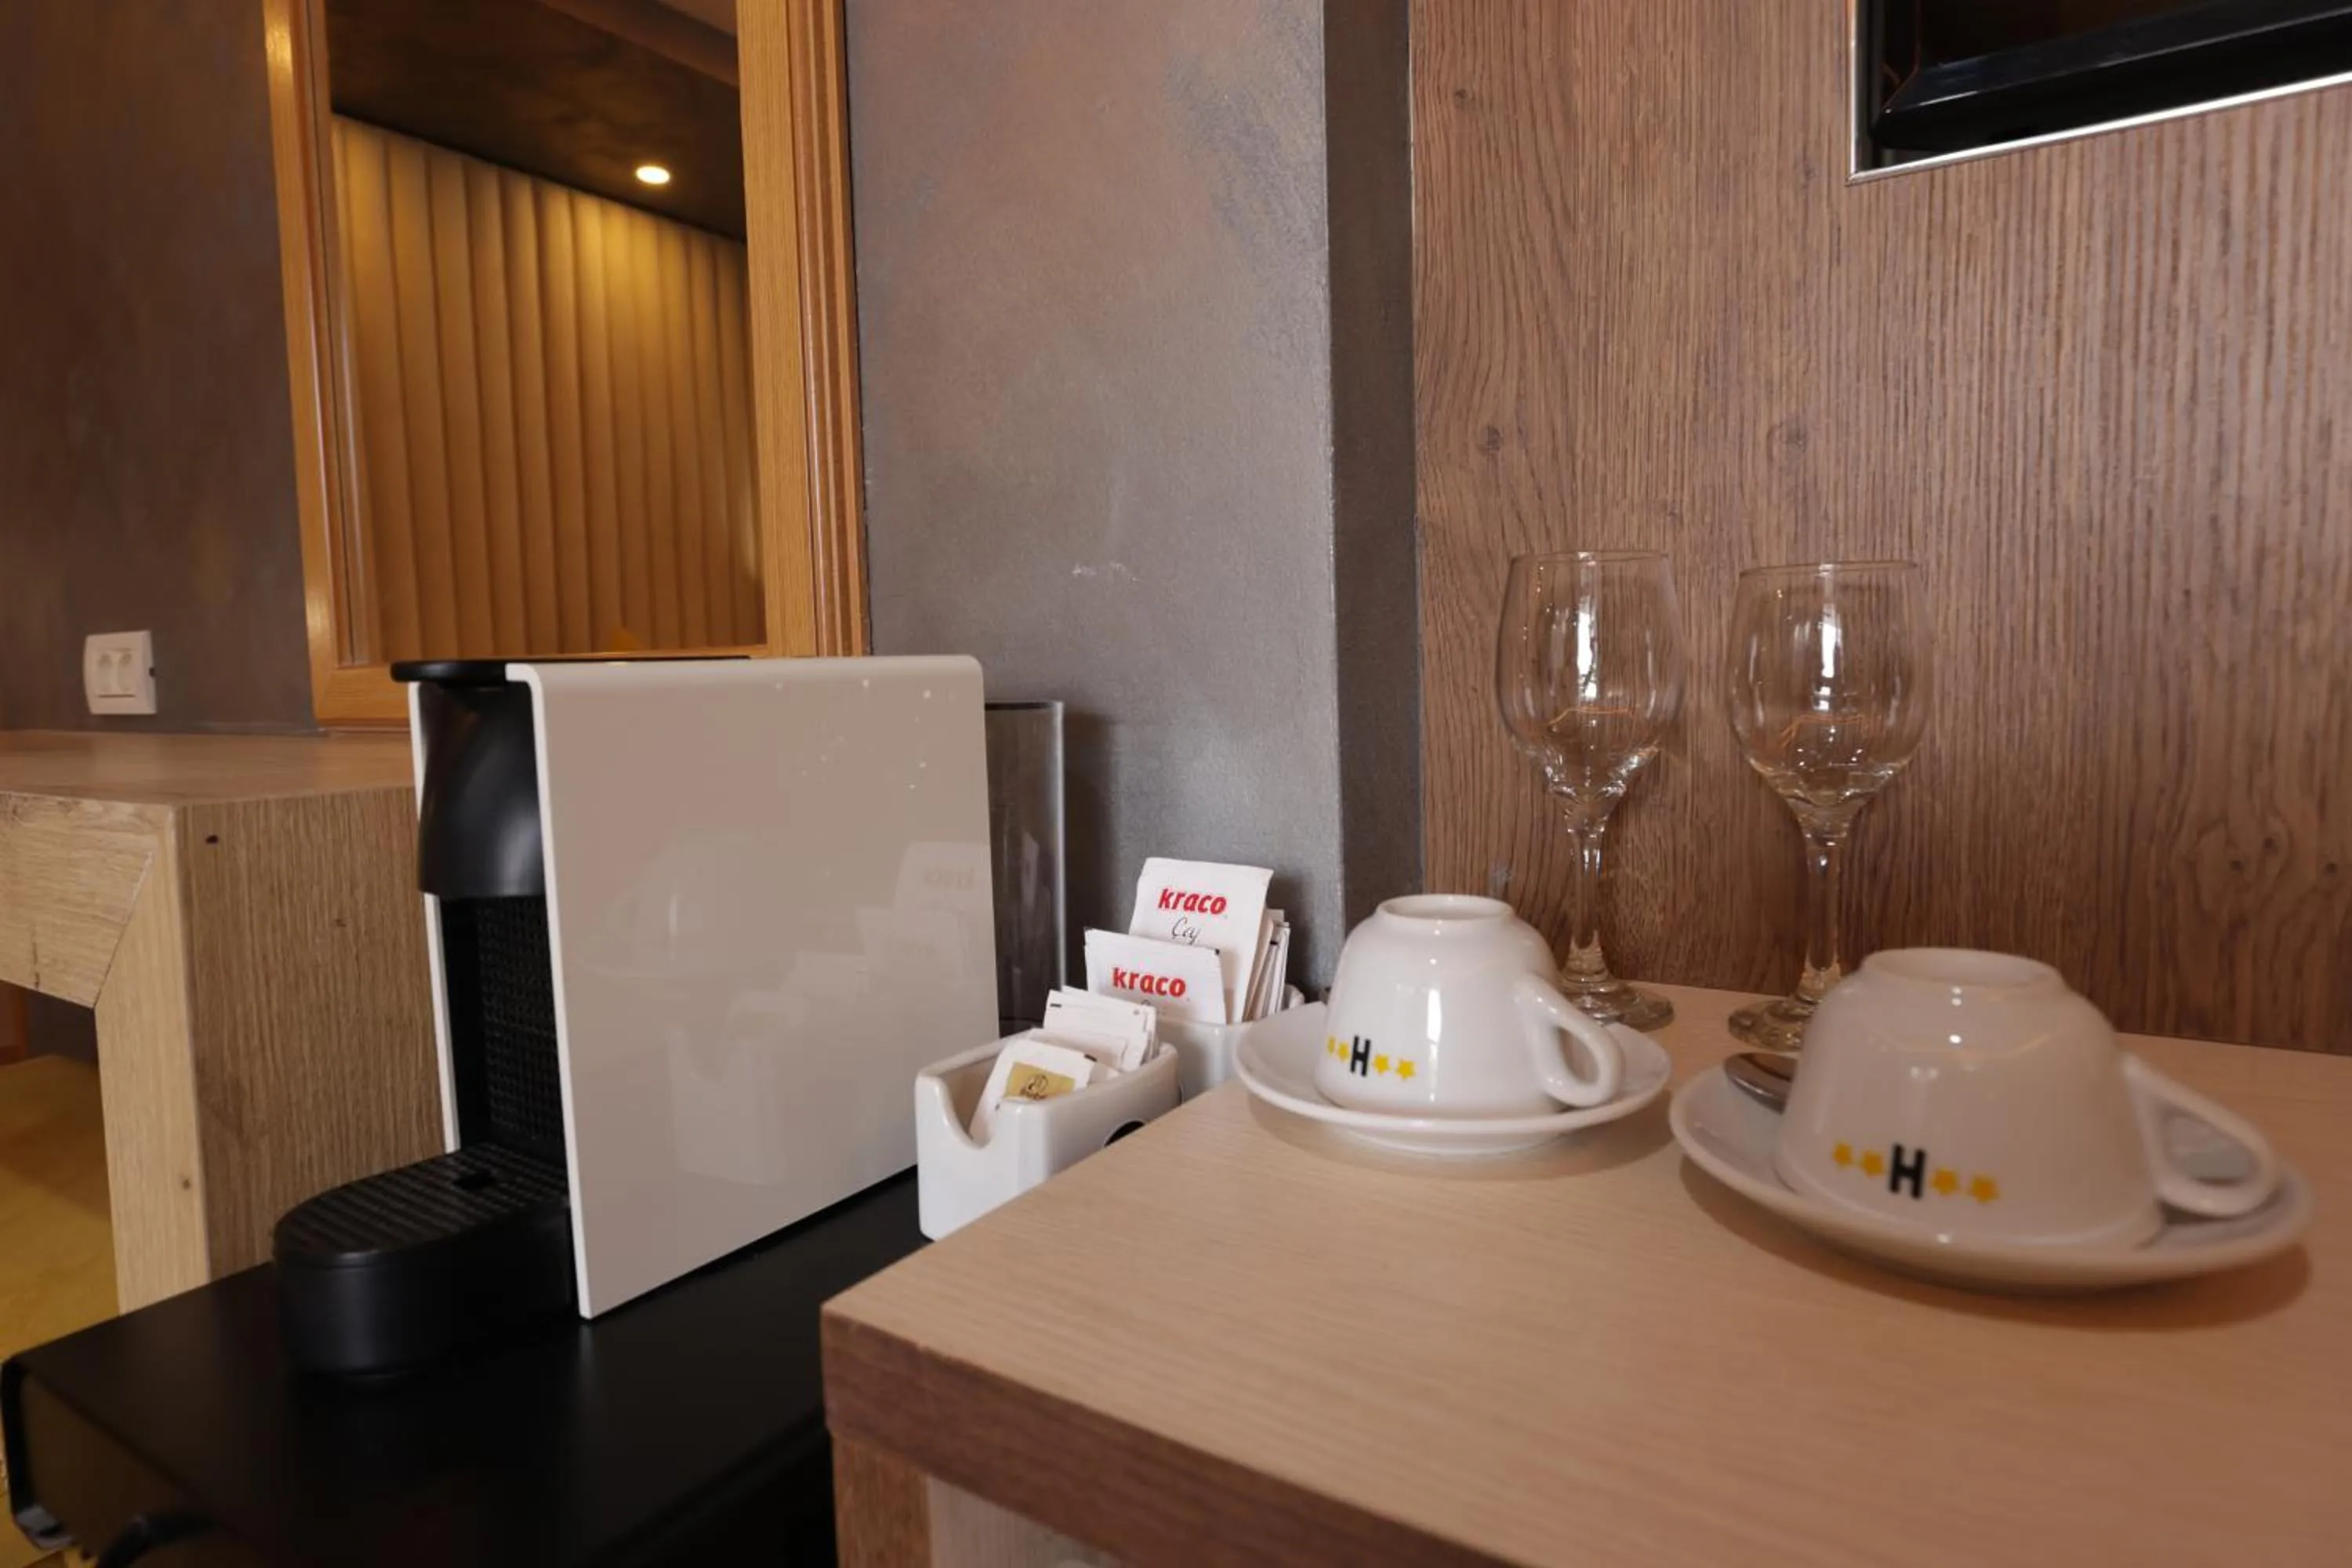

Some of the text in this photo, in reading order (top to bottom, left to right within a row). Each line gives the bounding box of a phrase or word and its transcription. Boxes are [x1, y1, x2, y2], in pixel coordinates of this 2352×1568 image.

[1158, 887, 1227, 915] kraco
[1113, 967, 1186, 997] kraco
[1350, 1035, 1371, 1077] H
[1889, 1143, 1927, 1200] H
